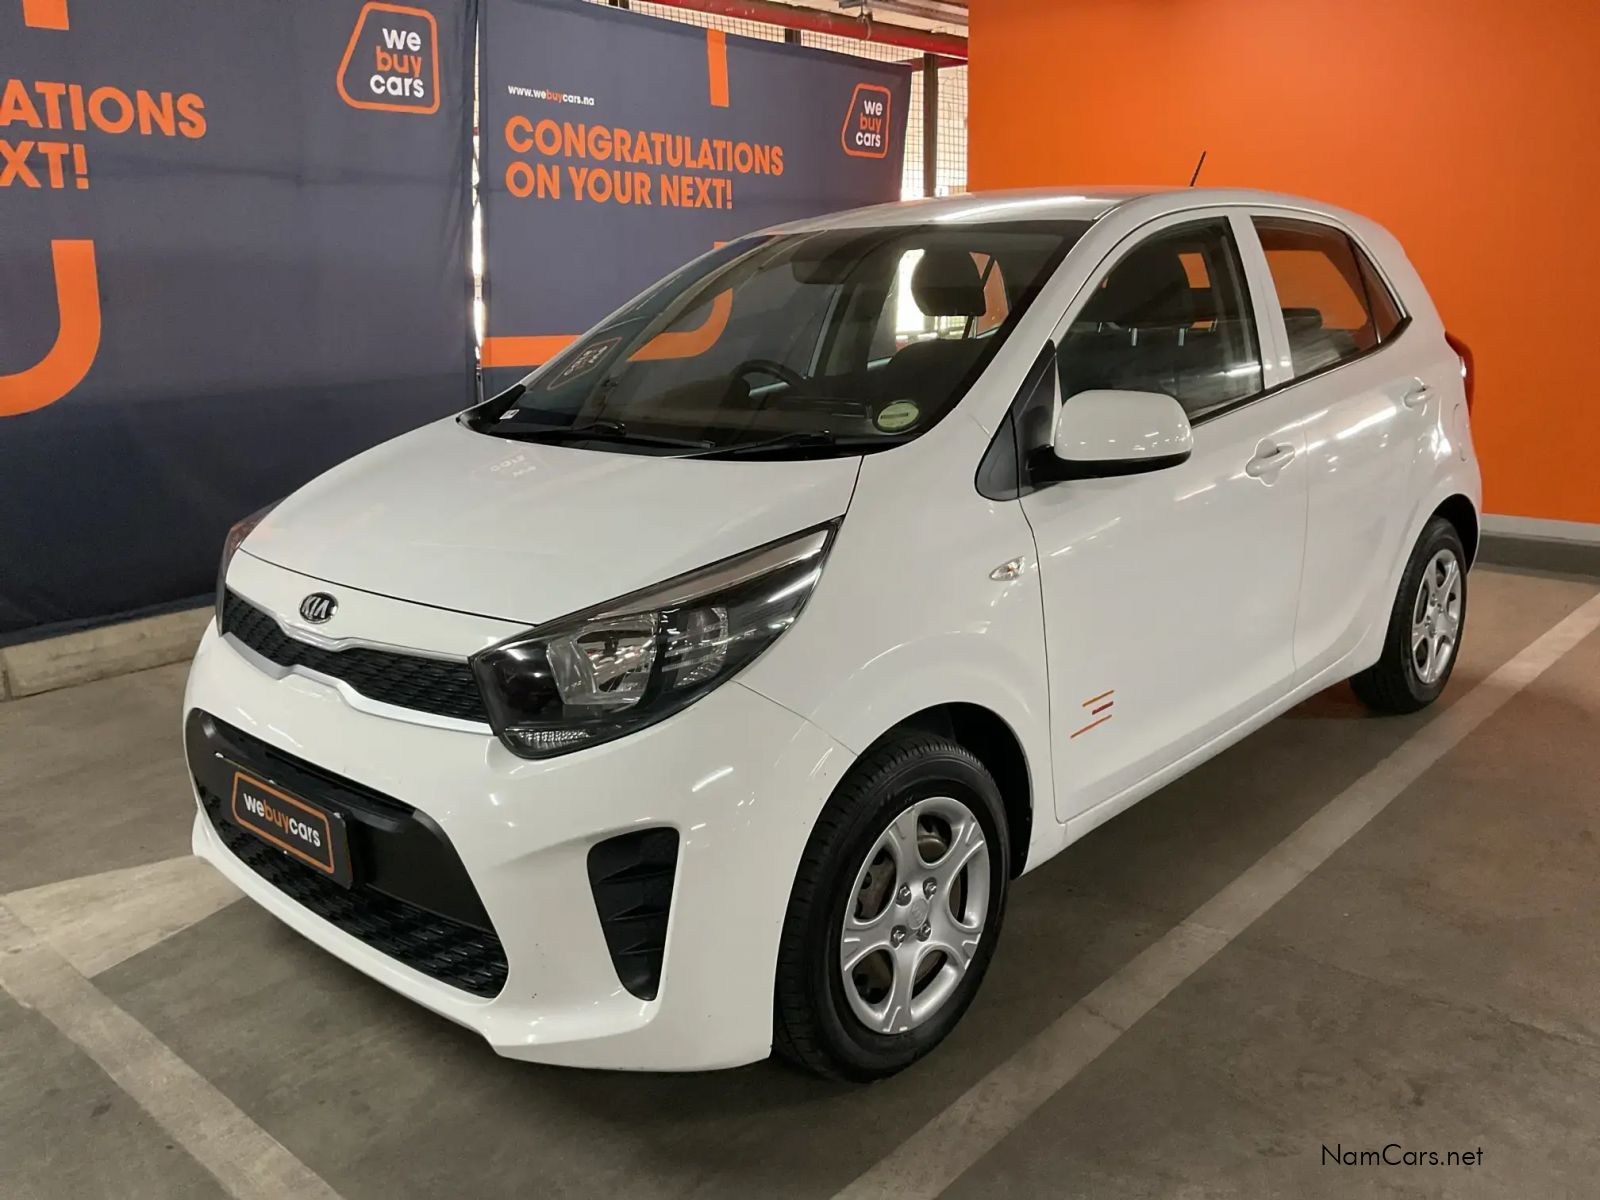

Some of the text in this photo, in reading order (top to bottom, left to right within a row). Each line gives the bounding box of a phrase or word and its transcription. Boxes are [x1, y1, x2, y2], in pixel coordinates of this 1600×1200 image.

[382, 27, 421, 52] we
[376, 46, 422, 77] buy
[370, 74, 424, 98] cars
[508, 86, 595, 106] www.webuycars.na
[0, 79, 207, 139] ATIONS
[864, 100, 883, 116] we
[860, 112, 882, 134] buy
[505, 115, 784, 176] CONGRATULATIONS
[855, 131, 881, 148] cars
[505, 161, 733, 209] ON YOUR NEXT!
[301, 596, 330, 619] KIA
[243, 792, 321, 848] webuycars
